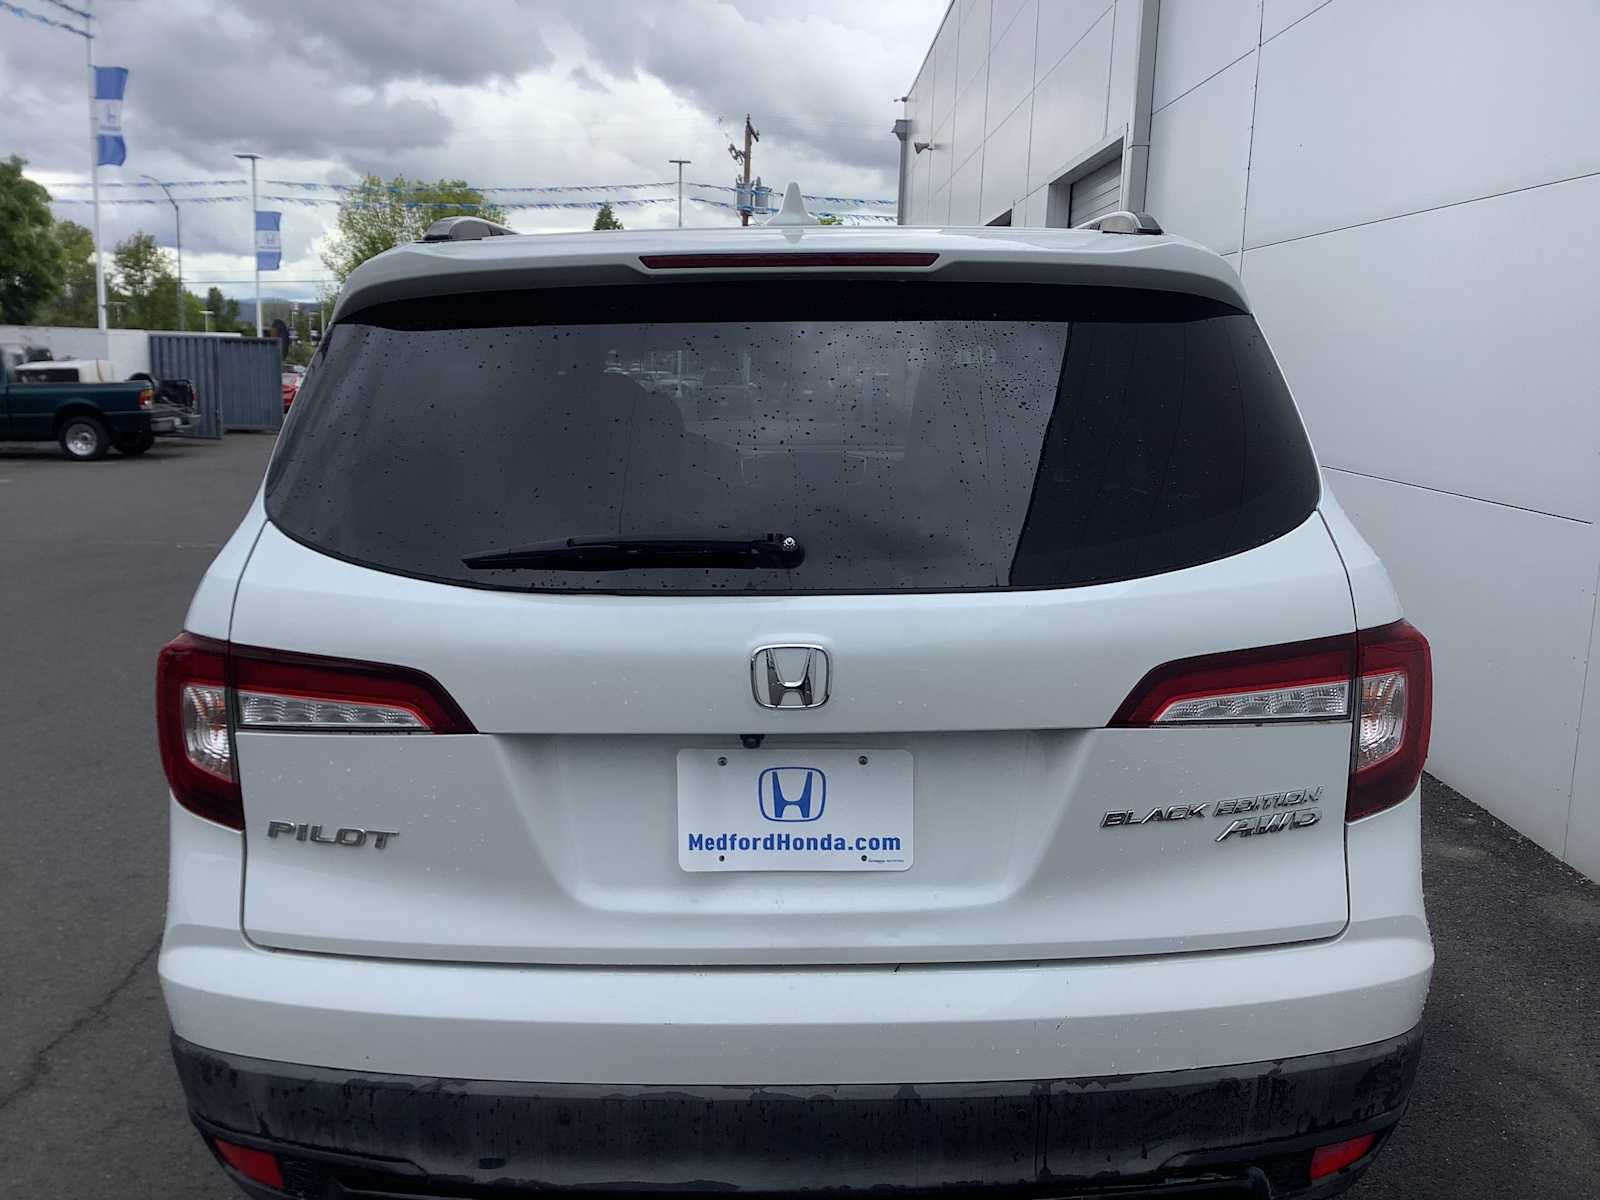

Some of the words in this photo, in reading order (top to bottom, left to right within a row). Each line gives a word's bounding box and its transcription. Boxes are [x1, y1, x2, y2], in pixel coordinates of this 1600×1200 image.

[1100, 803, 1208, 828] BLACK
[1213, 786, 1324, 817] EDITION
[267, 820, 400, 849] PILOT
[1215, 807, 1323, 842] AWD
[688, 833, 901, 851] MedfordHonda.com
